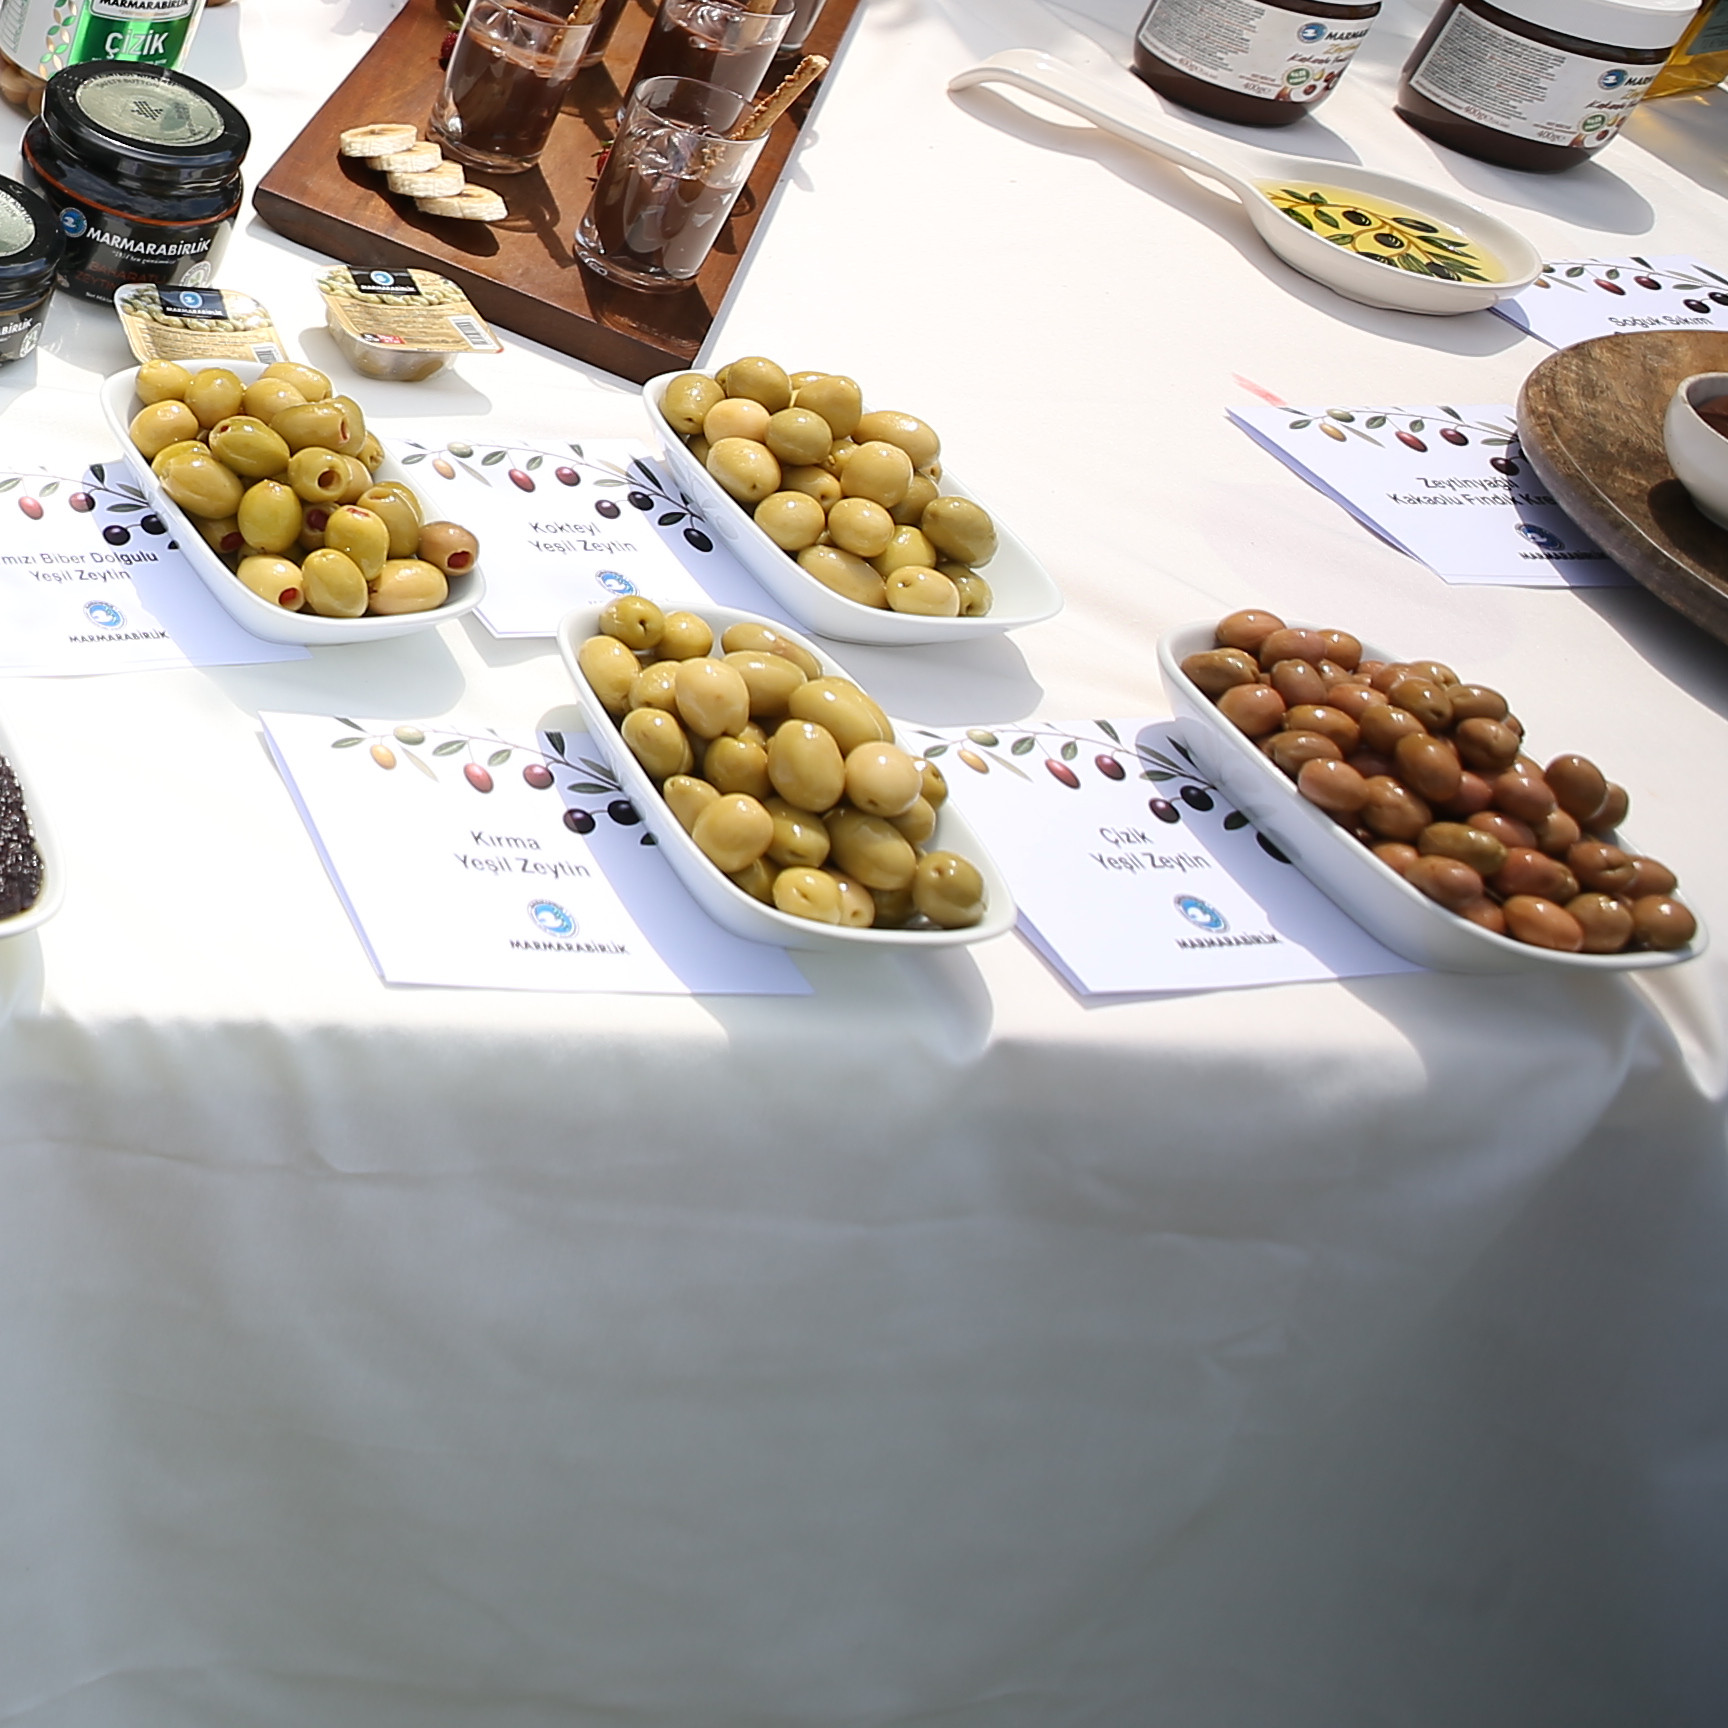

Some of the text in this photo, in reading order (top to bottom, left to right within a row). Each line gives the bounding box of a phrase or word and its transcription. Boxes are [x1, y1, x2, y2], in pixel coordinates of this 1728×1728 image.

[104, 29, 168, 60] ÇİZİK
[86, 227, 210, 256] MARMARABİRLİK
[1416, 477, 1519, 491] Zeytinyağlı
[1387, 493, 1461, 505] Kakaolu
[1461, 493, 1518, 506] Fındık
[528, 522, 601, 536] Kokteyl
[528, 539, 638, 554] Yeşil Zeytin
[40, 553, 86, 564] Biber
[90, 551, 159, 566] Dolgulu
[29, 570, 131, 584] Yeşil Zeytin
[68, 629, 169, 644] MARMARABİRLİK
[470, 830, 542, 851] Kırma
[1099, 827, 1154, 849] Çizik
[453, 852, 591, 879] Yeşil Zeytin
[1089, 852, 1212, 874] Yeşil Zeytin
[510, 939, 630, 955] MARMARABİRLİK
[1175, 930, 1282, 950] MARMARABİRLİK
